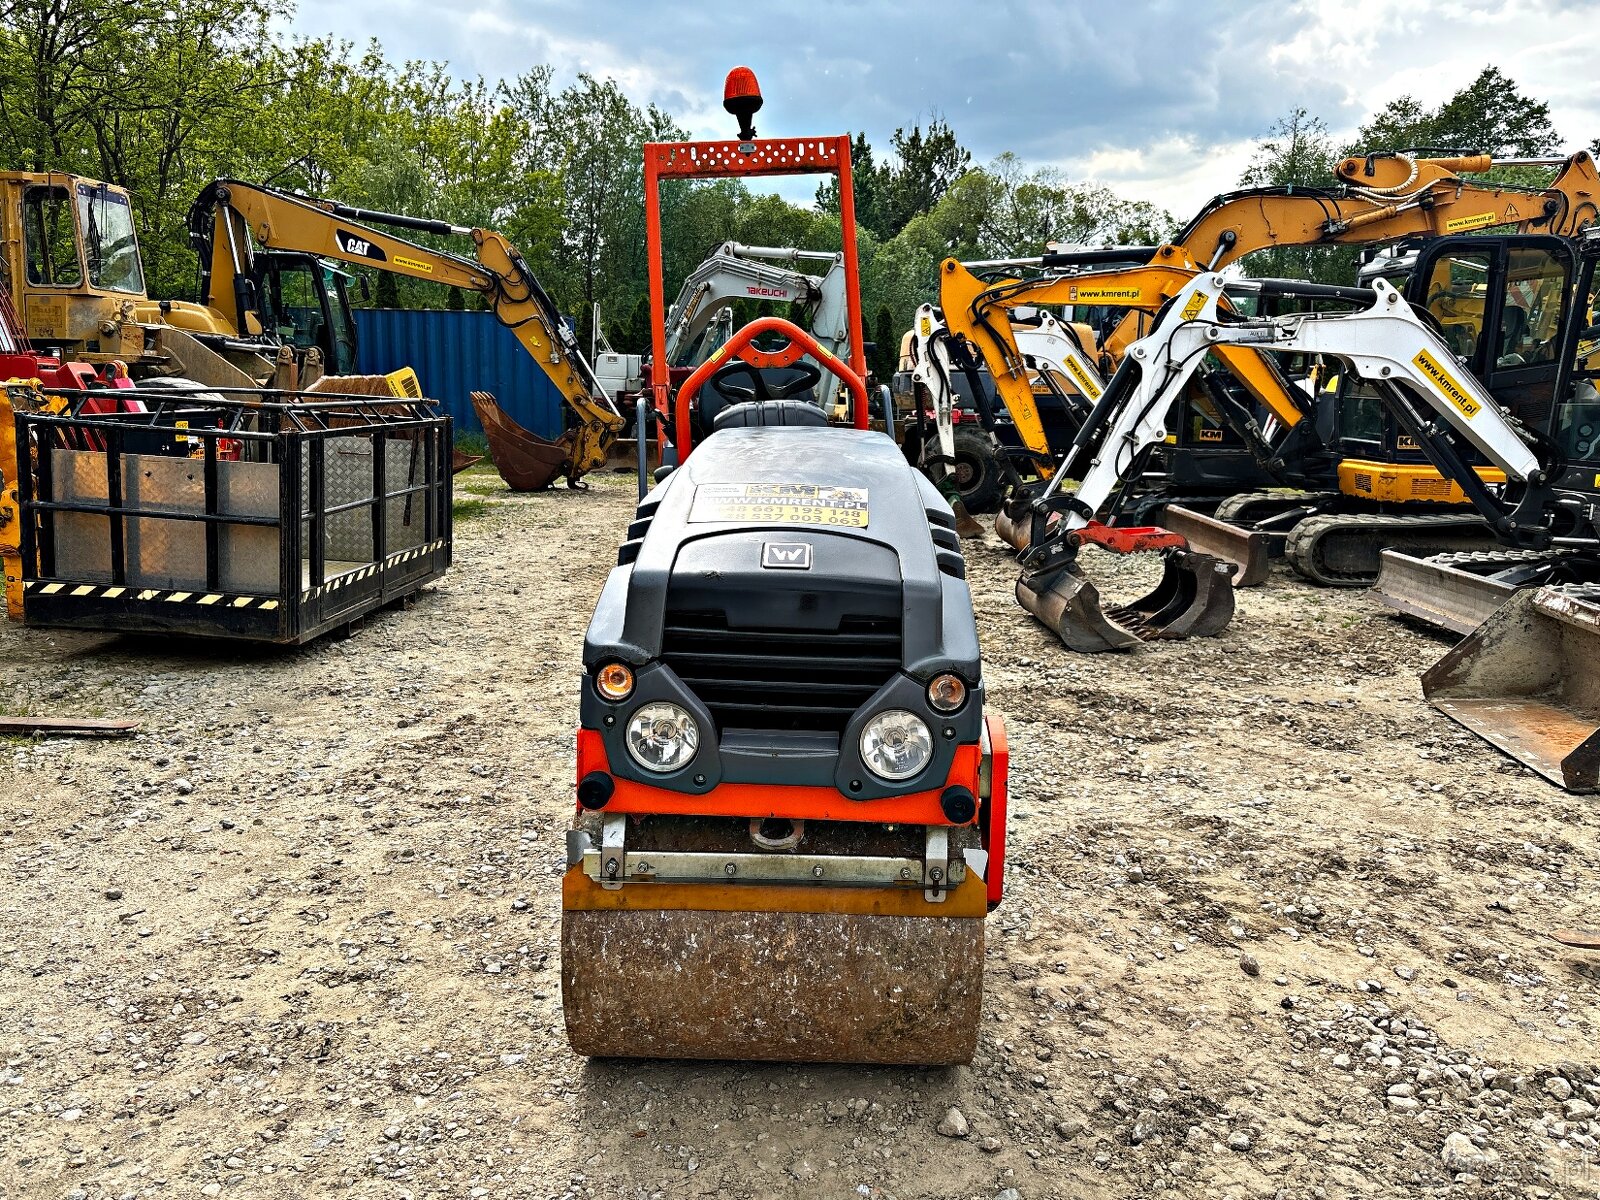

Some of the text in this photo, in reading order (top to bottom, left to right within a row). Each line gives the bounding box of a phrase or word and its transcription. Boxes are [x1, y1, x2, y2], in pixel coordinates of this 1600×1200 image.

[1448, 214, 1494, 228] www.kmrent.pl
[347, 238, 371, 256] CAT
[746, 286, 788, 298] TAKEUCHI
[1079, 290, 1140, 299] www.kmrent.pl
[1066, 357, 1099, 398] www.kmrent.pl
[1418, 354, 1477, 415] www.kmrent.pl
[1201, 430, 1222, 439] KM
[703, 497, 867, 511] WW.KMRENT.PL
[752, 505, 784, 513] 661
[793, 507, 823, 515] 195
[831, 509, 861, 518] 148
[789, 514, 822, 523] 003
[828, 517, 861, 526] 063
